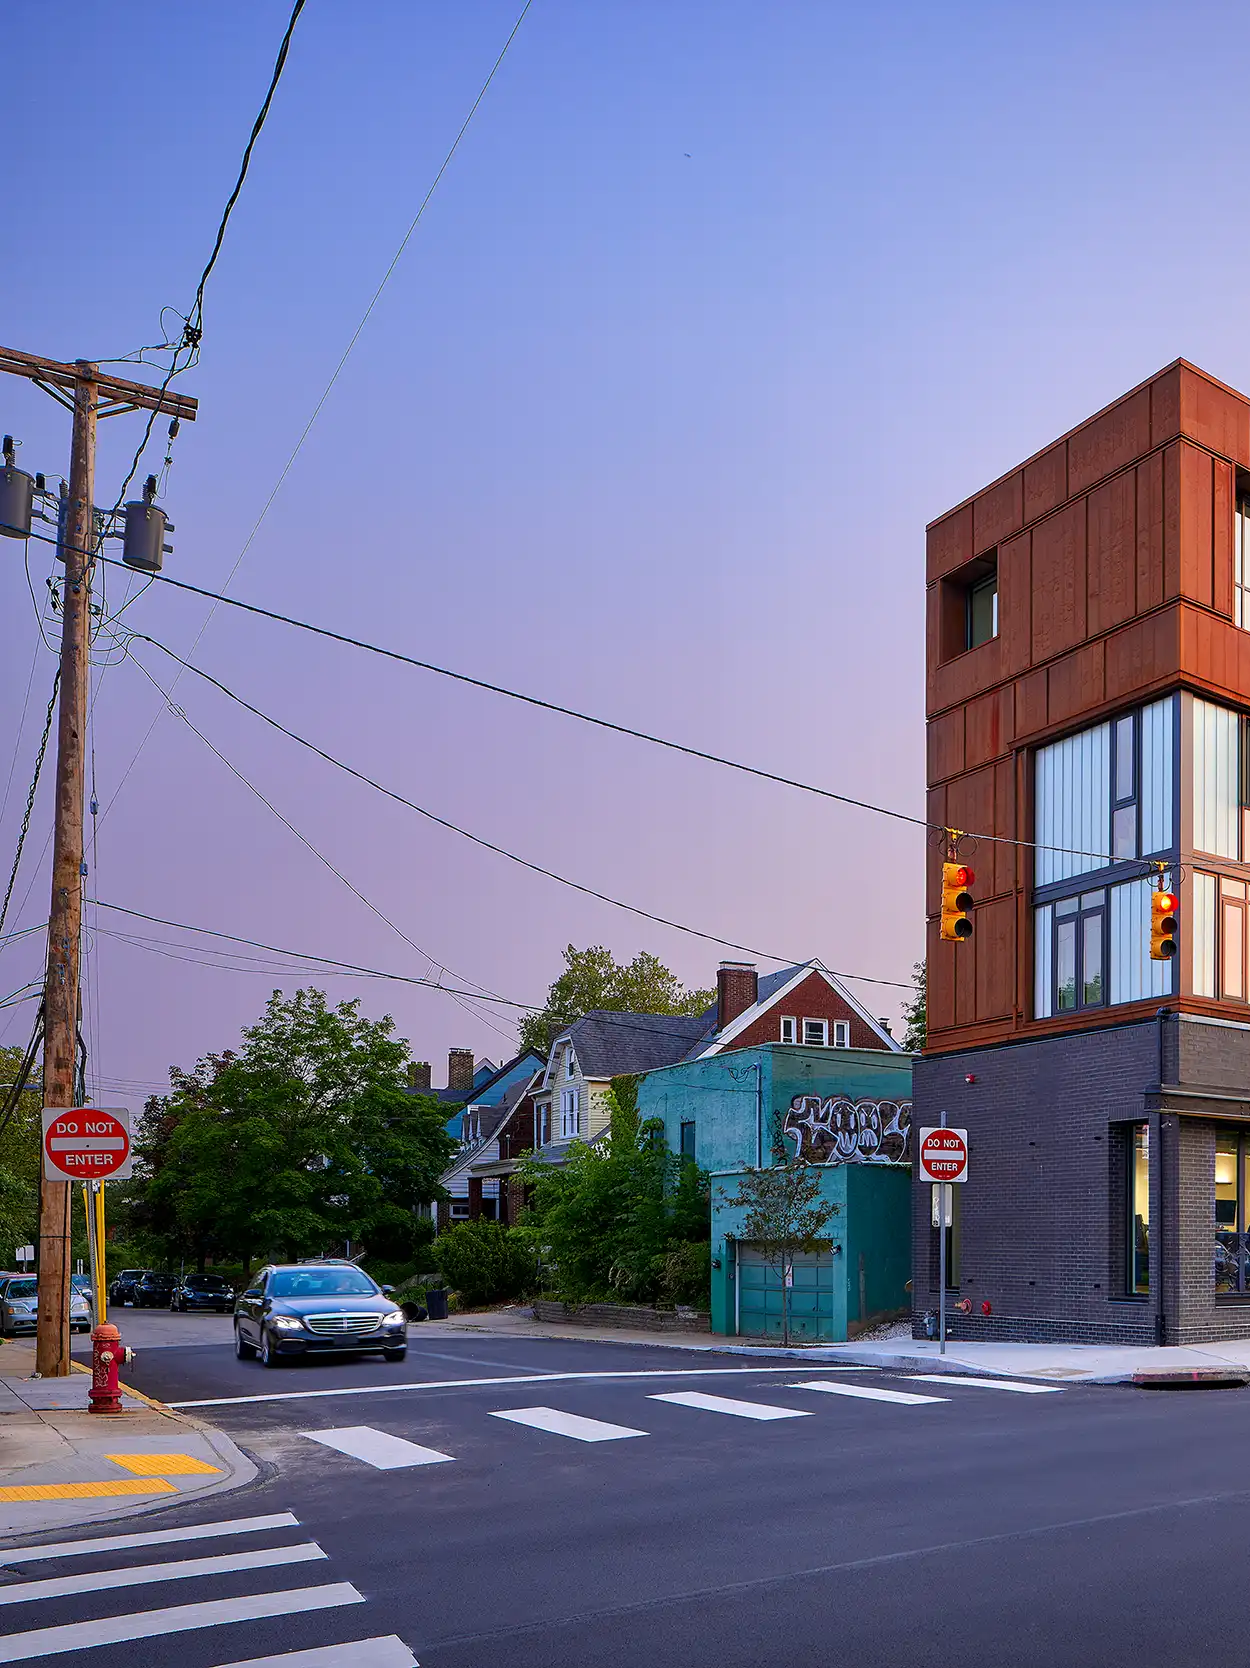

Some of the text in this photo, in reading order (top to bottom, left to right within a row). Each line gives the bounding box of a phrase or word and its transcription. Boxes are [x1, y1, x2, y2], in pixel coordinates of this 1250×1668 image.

[56, 1121, 115, 1134] DO NOT
[927, 1138, 960, 1148] DO NOT
[65, 1154, 114, 1166] ENTER
[931, 1162, 958, 1172] ENTER
